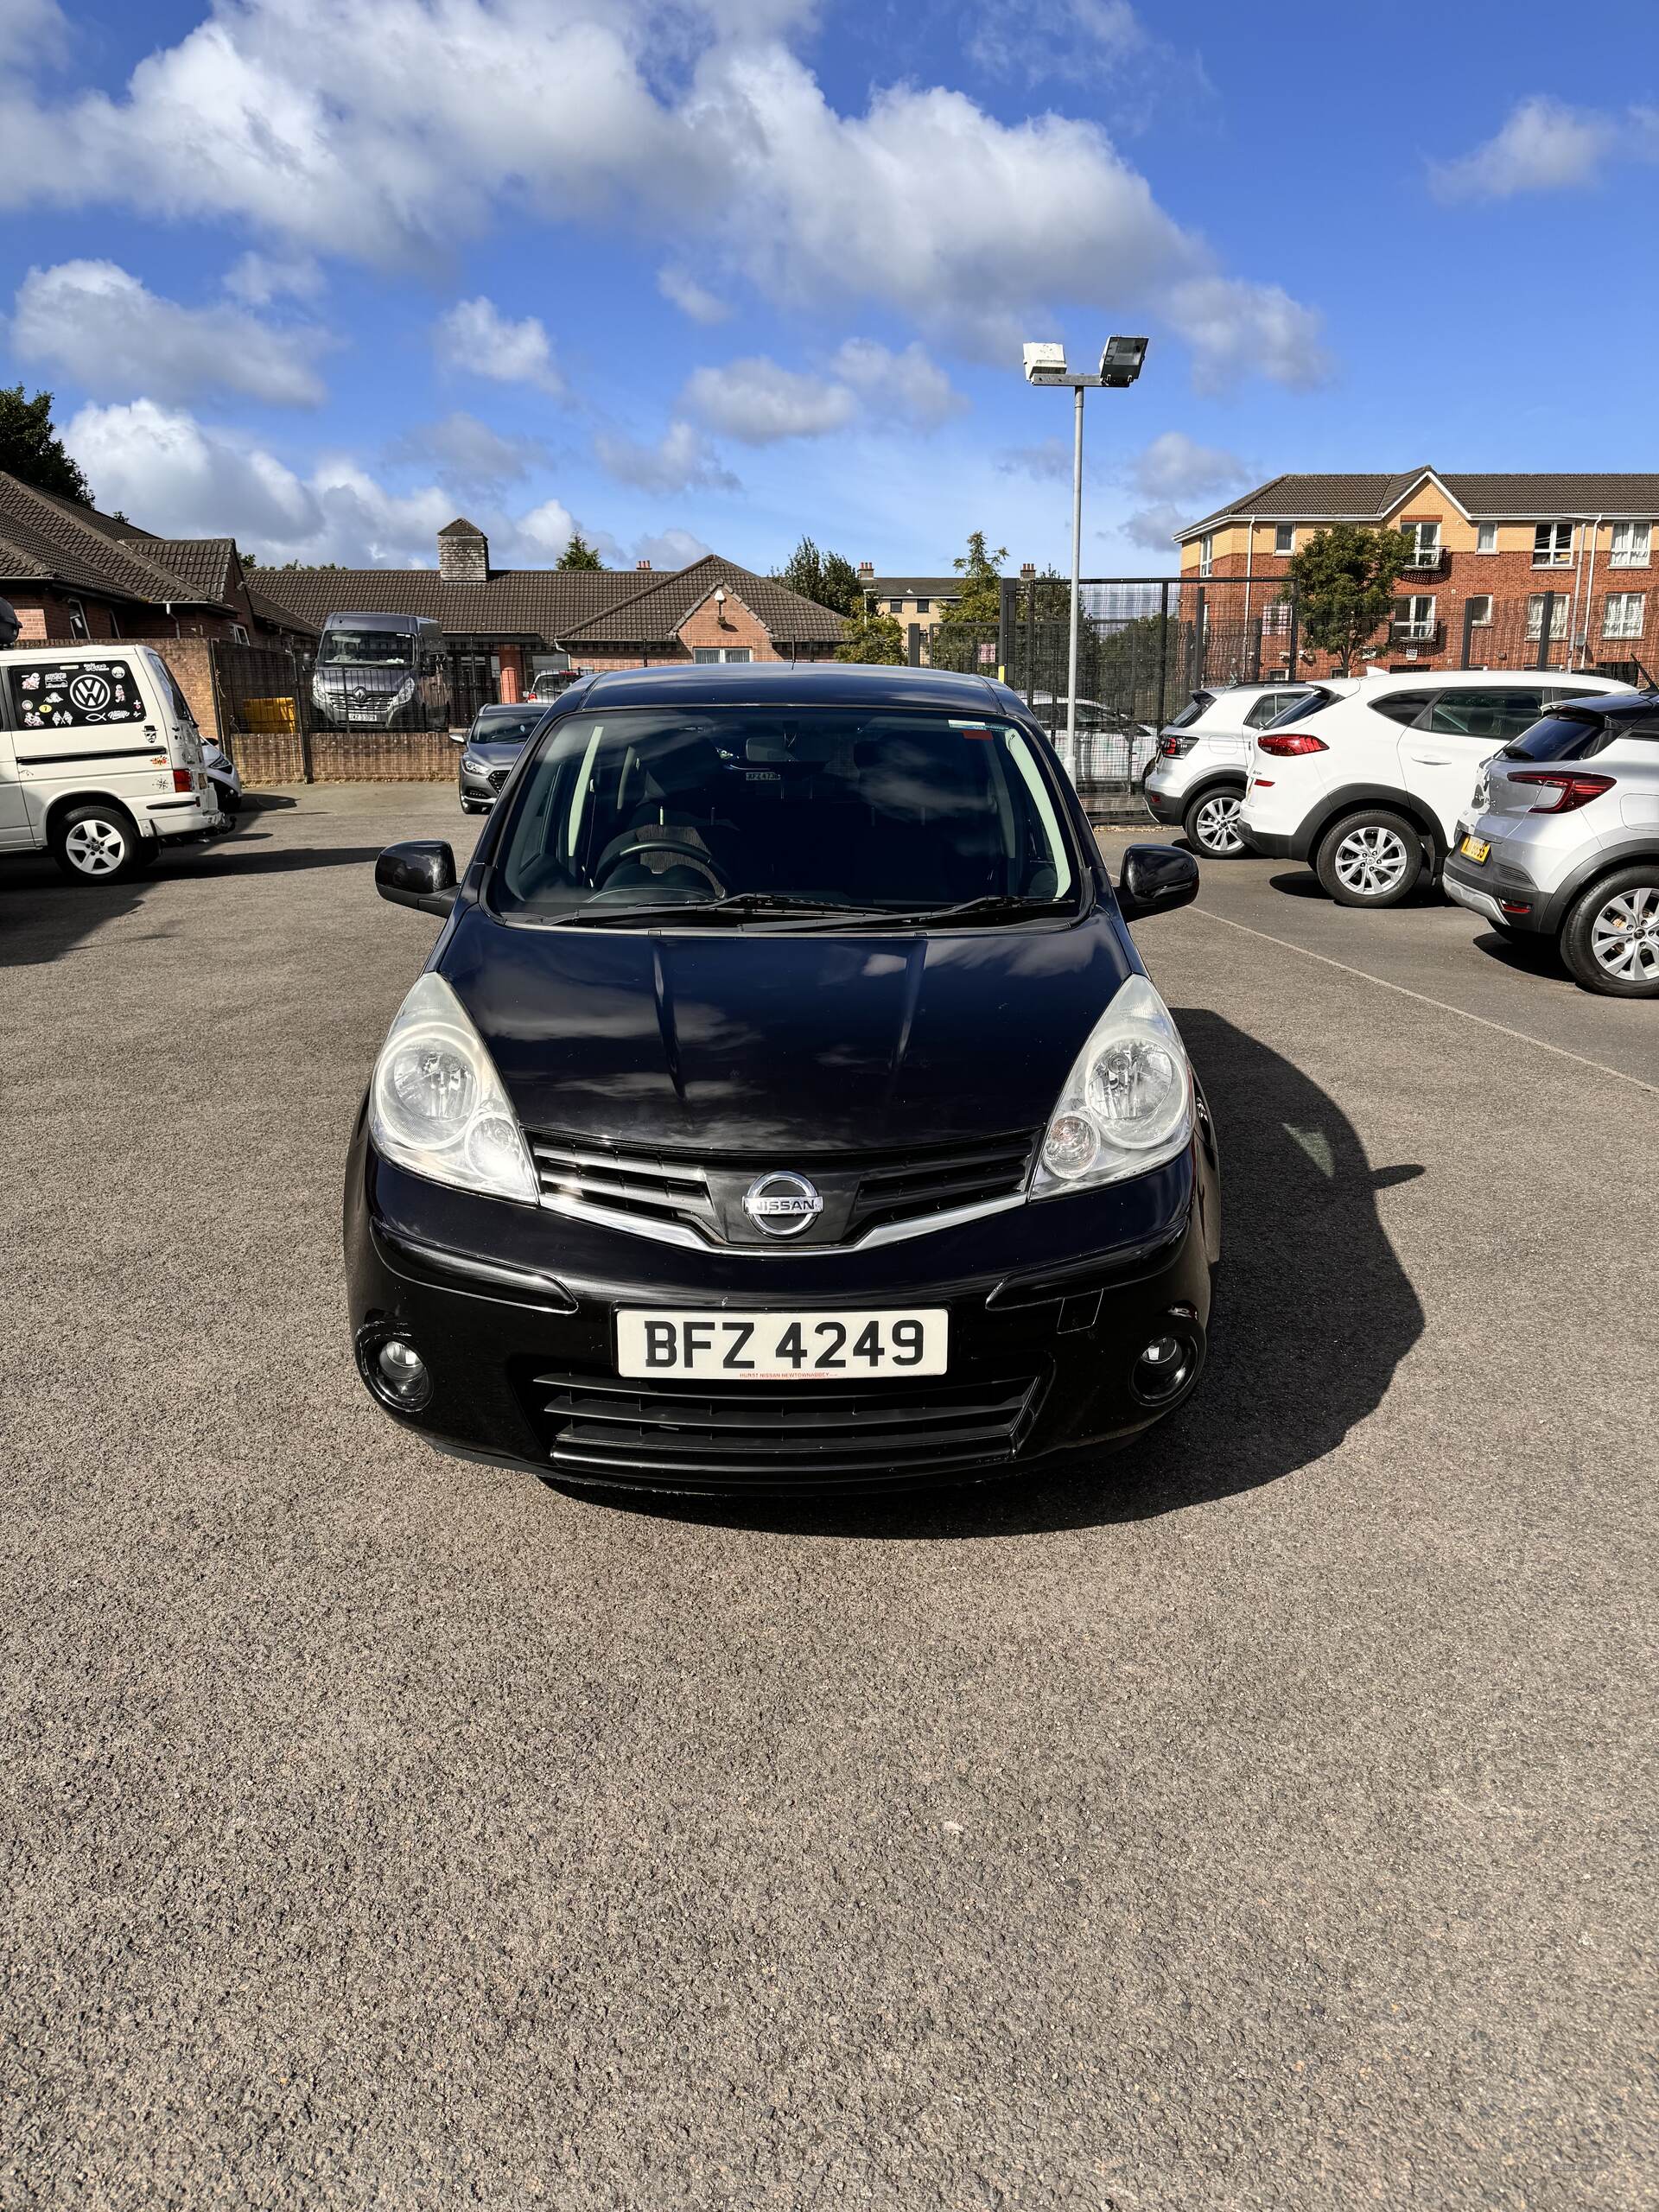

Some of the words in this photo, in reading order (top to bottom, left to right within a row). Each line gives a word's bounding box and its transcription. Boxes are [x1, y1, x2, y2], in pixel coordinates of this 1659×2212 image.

[756, 1199, 815, 1211] NISSAN
[645, 1321, 755, 1370] BFZ
[775, 1319, 925, 1369] 4249
